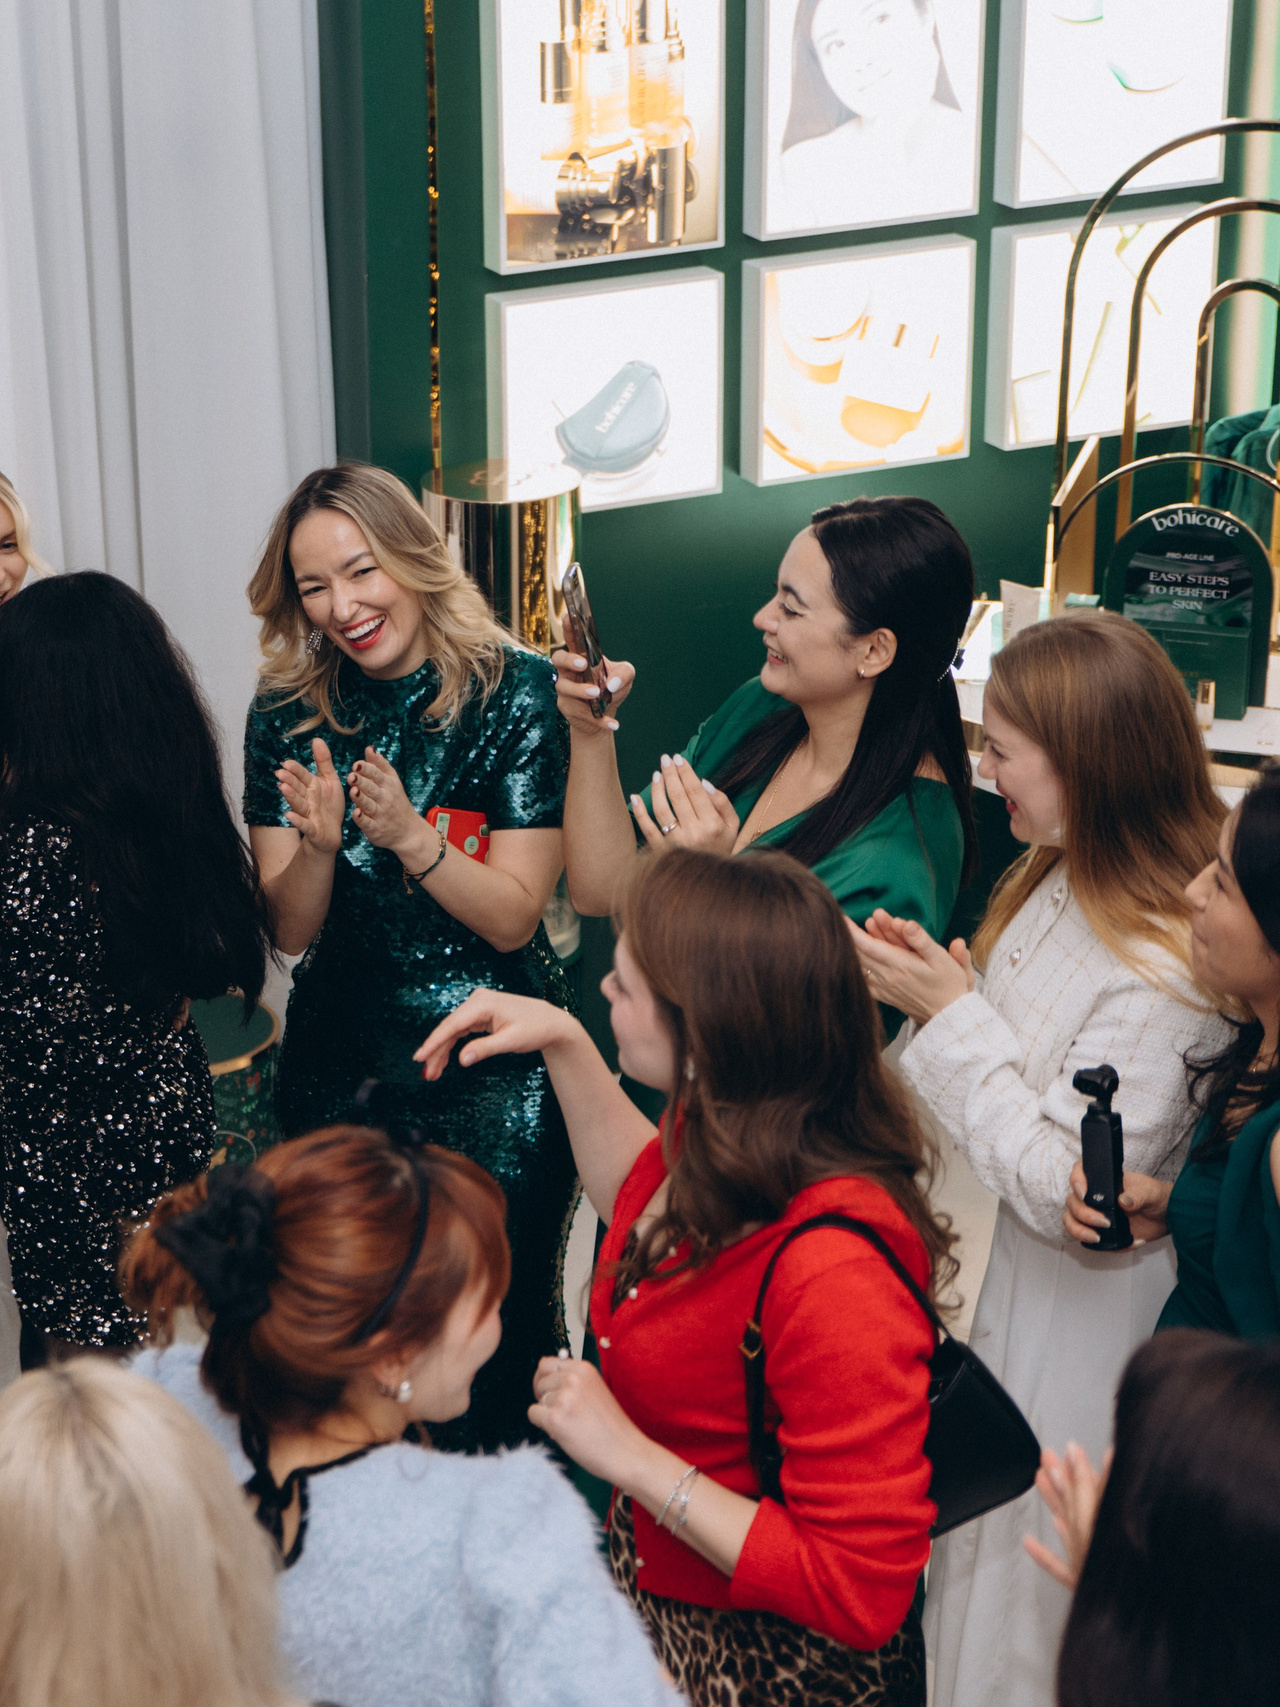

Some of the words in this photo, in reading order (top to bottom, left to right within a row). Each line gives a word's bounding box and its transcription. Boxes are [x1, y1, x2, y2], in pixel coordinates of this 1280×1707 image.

[1151, 509, 1240, 537] bohicare
[1149, 571, 1185, 583] EASY
[1186, 574, 1230, 586] STEPS
[1146, 584, 1167, 595] TO
[1168, 586, 1230, 600] PERFECT
[1172, 600, 1204, 611] SKIN
